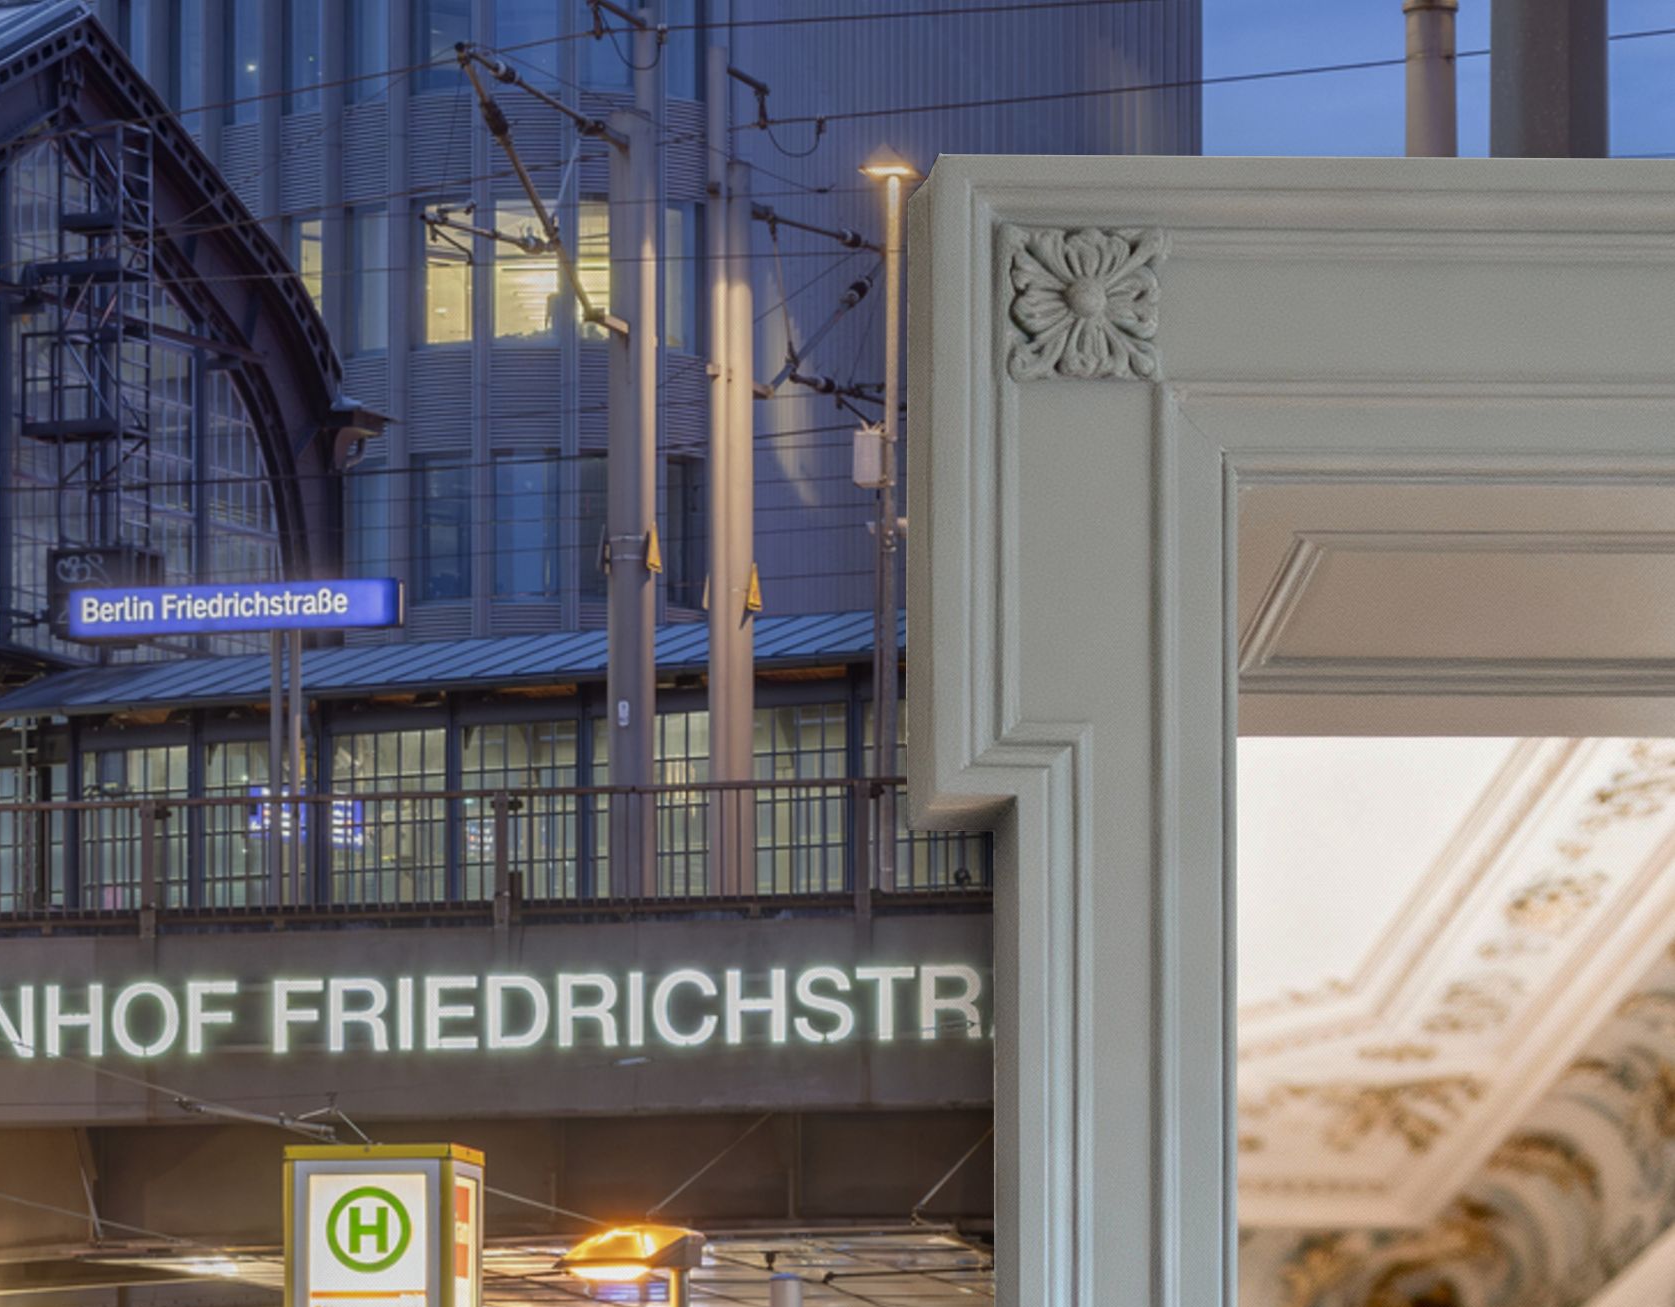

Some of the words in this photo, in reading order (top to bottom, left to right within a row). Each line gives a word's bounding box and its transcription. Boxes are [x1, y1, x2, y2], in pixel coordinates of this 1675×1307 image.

[81, 596, 154, 624] Berlin
[160, 588, 349, 620] Friedrichstraße
[271, 963, 994, 1054] FRIEDRICHSTR
[348, 1206, 389, 1254] H
